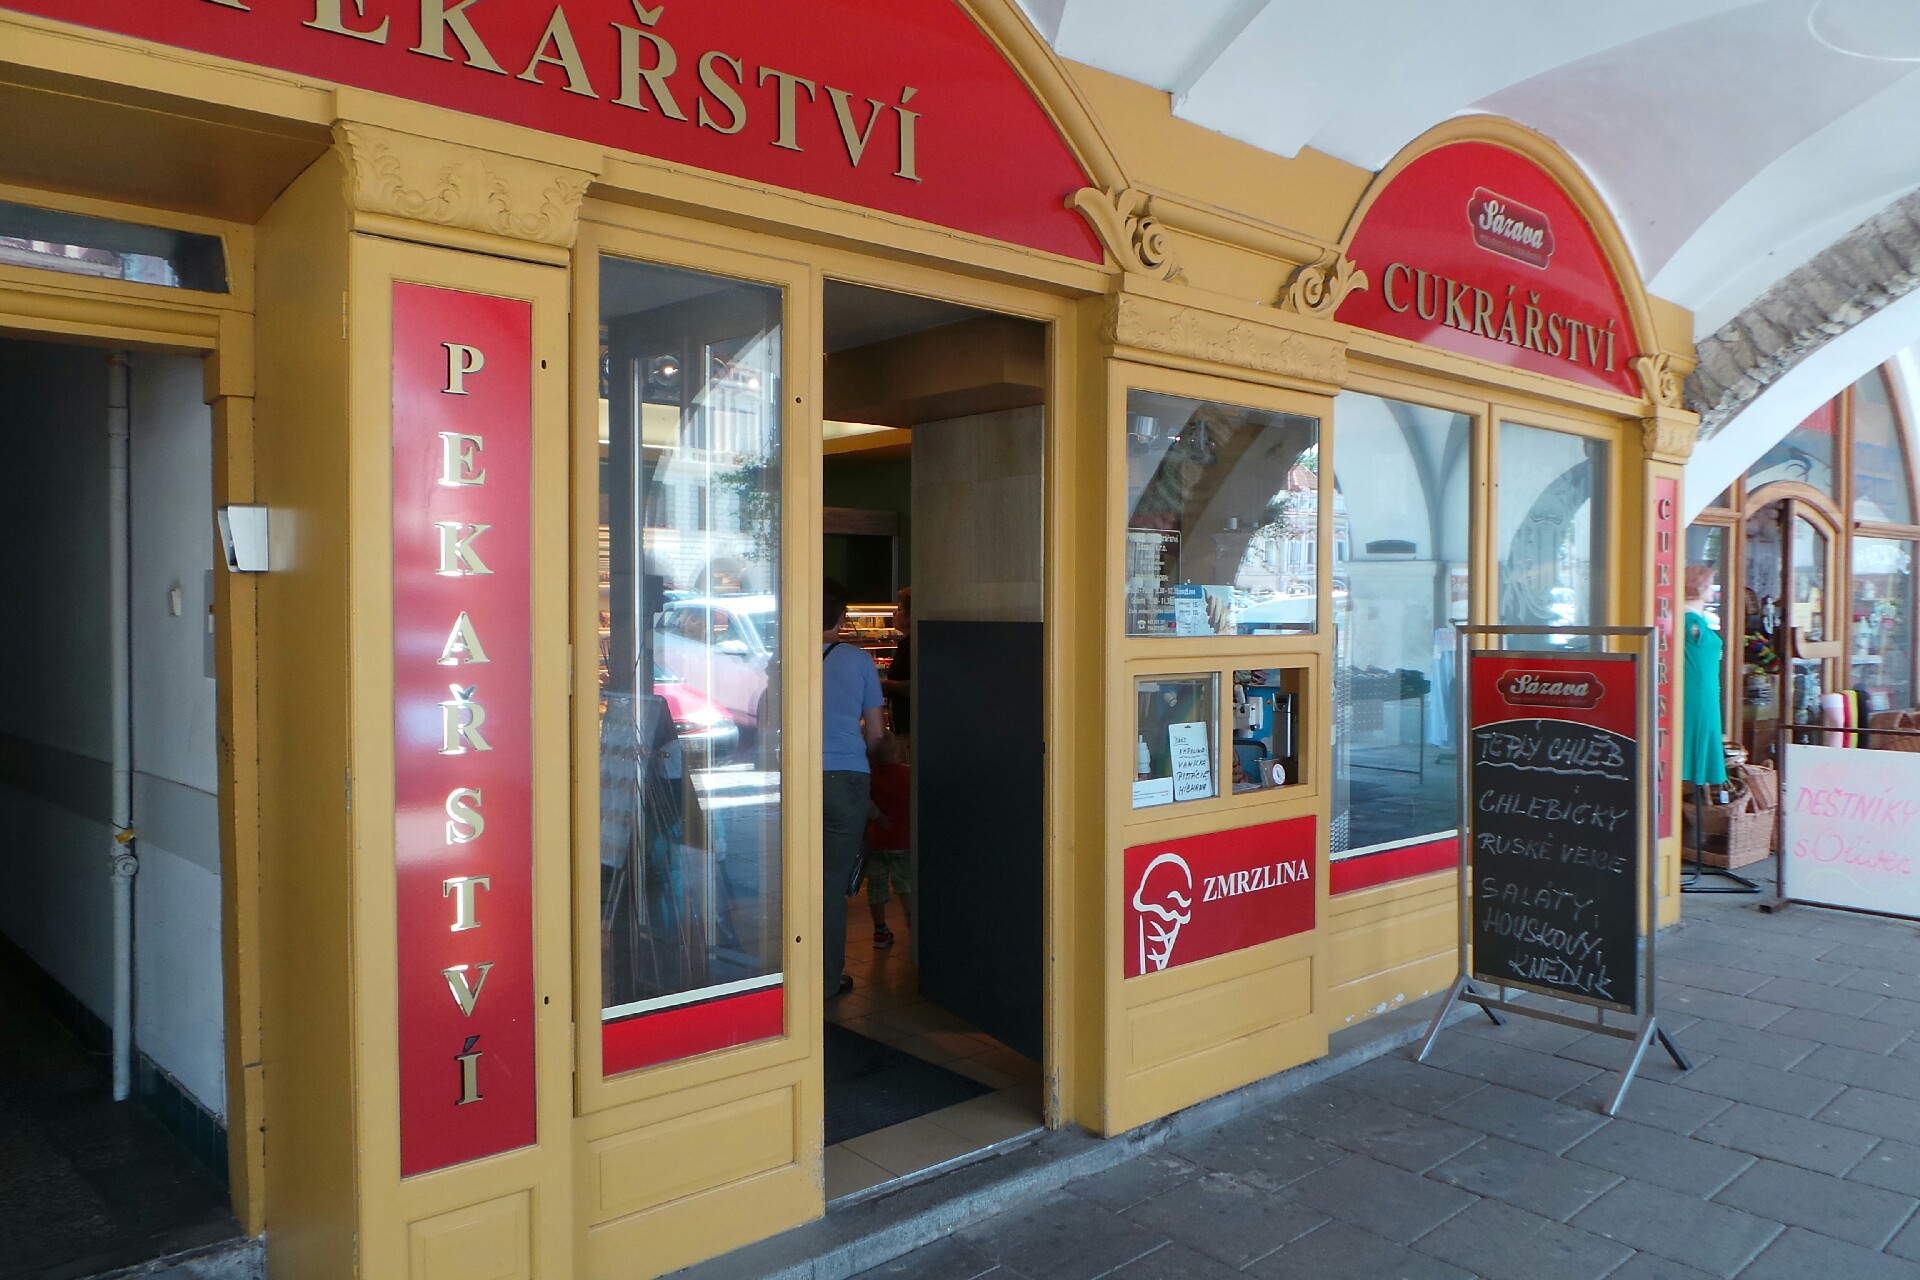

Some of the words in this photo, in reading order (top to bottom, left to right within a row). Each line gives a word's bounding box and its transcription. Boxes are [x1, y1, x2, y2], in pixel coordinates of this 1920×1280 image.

[205, 0, 922, 182] KAŘSTVÍ
[1479, 199, 1544, 250] Sázava
[1383, 262, 1616, 373] CUKRÁŘSTVÍ
[434, 341, 494, 1107] PEKAŘSTVÍ
[1509, 674, 1589, 697] Sázava
[1203, 857, 1309, 903] ZMRZLINA
